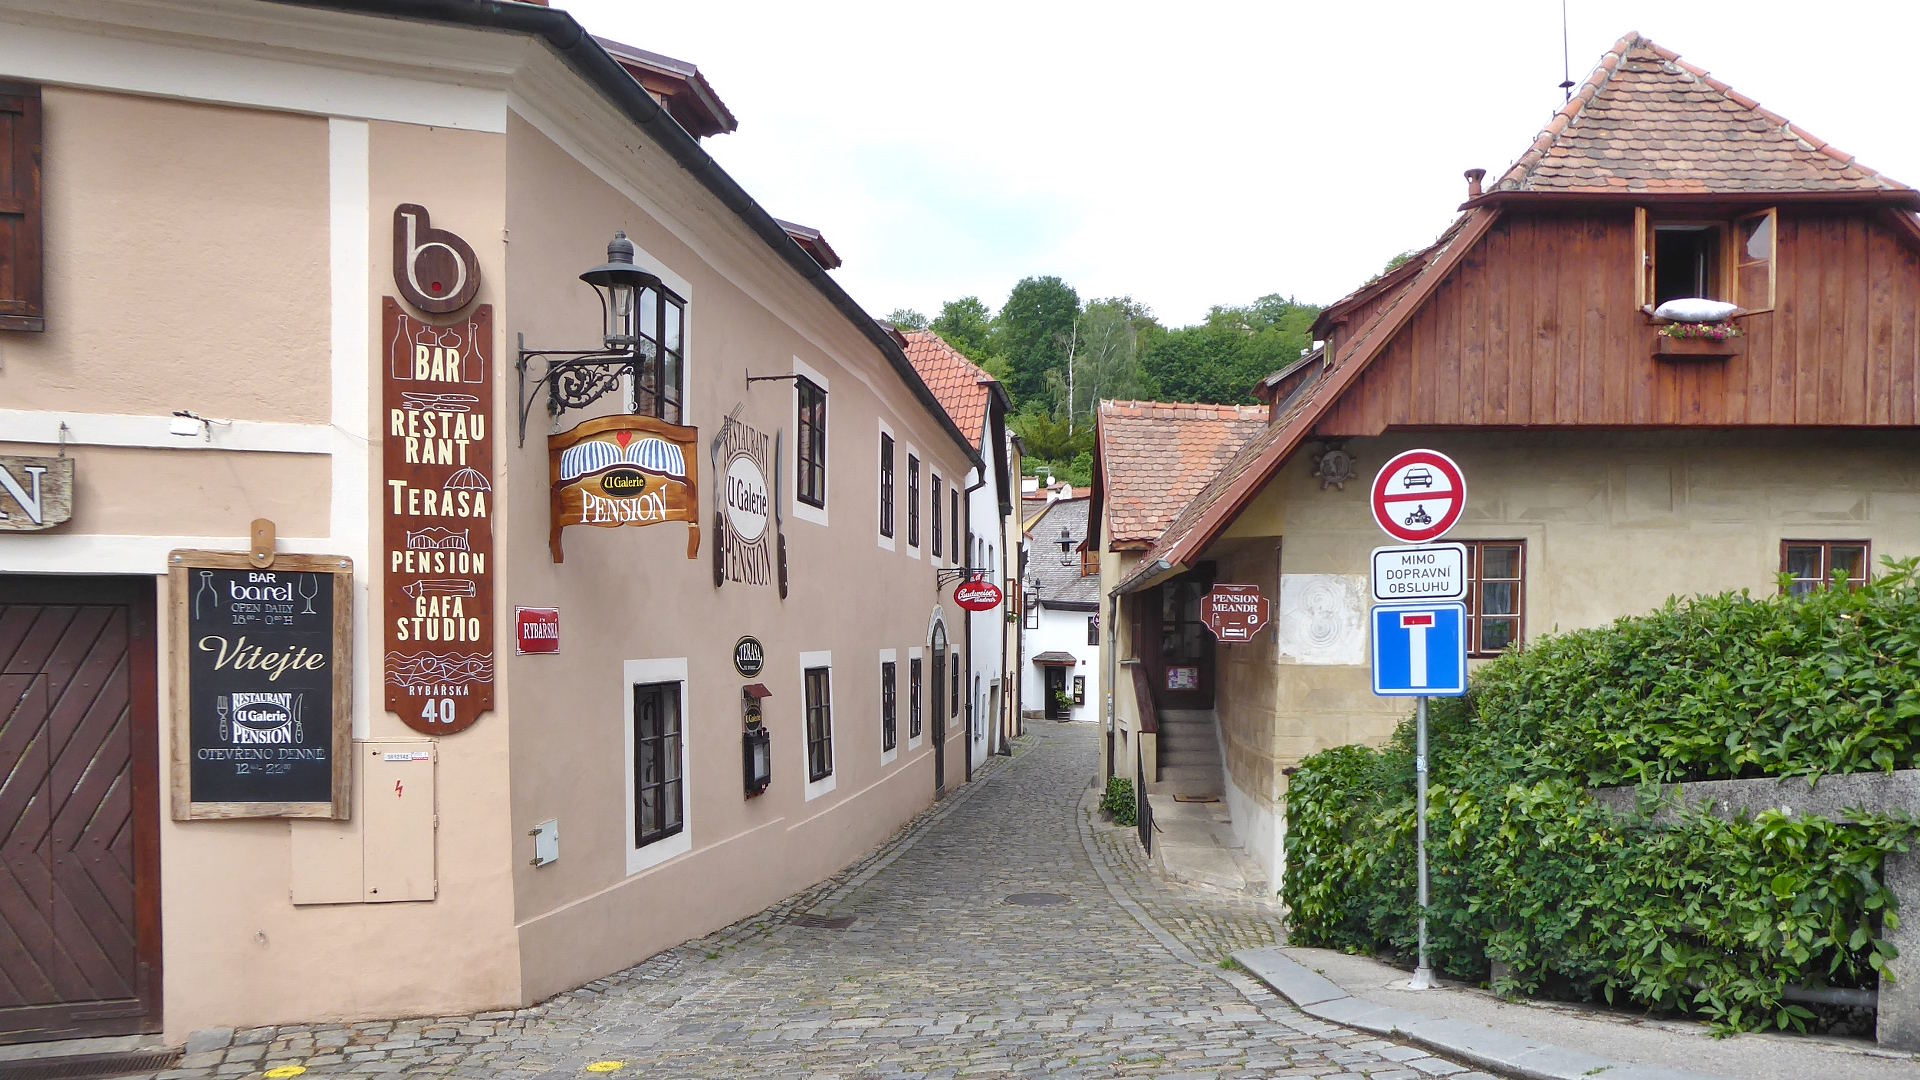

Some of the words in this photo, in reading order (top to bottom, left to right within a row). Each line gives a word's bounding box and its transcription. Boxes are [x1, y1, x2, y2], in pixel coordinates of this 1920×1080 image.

[415, 345, 460, 383] BAR
[391, 409, 485, 441] RESTAU
[405, 436, 470, 466] RANT
[724, 415, 769, 482] RESTAURANT
[604, 476, 613, 489] U
[614, 476, 644, 488] Galerie
[388, 479, 486, 518] TERASA
[580, 483, 668, 524] PENSION
[728, 475, 735, 508] U
[737, 479, 767, 517] Galerie
[724, 509, 772, 587] PENSION
[392, 550, 485, 575] PENSION
[1401, 554, 1435, 565] MIMO
[249, 572, 277, 583] BAR
[1387, 565, 1452, 580] DOPRAVNÍ
[230, 580, 294, 601] barel
[957, 588, 998, 601] Budweiser
[1389, 581, 1449, 593] OBSLUHU
[231, 602, 261, 613] OPEN
[265, 604, 294, 614] DAILY
[415, 595, 464, 618] GAFA
[1212, 594, 1260, 604] PENSION
[1212, 603, 1258, 613] MEANDR
[396, 617, 480, 642] STUDIO
[523, 618, 558, 639] RYBÁŘSKÁ
[198, 635, 326, 682] Vítejte
[739, 642, 761, 661] TERASA
[409, 684, 470, 696] RYBÁŘSKÁ
[232, 692, 292, 711] RESTAURANT
[421, 698, 456, 724] 40
[237, 711, 247, 722] U
[248, 710, 287, 722] Galerie
[232, 721, 292, 744] PENSION
[198, 746, 274, 760] OTEVŘENO
